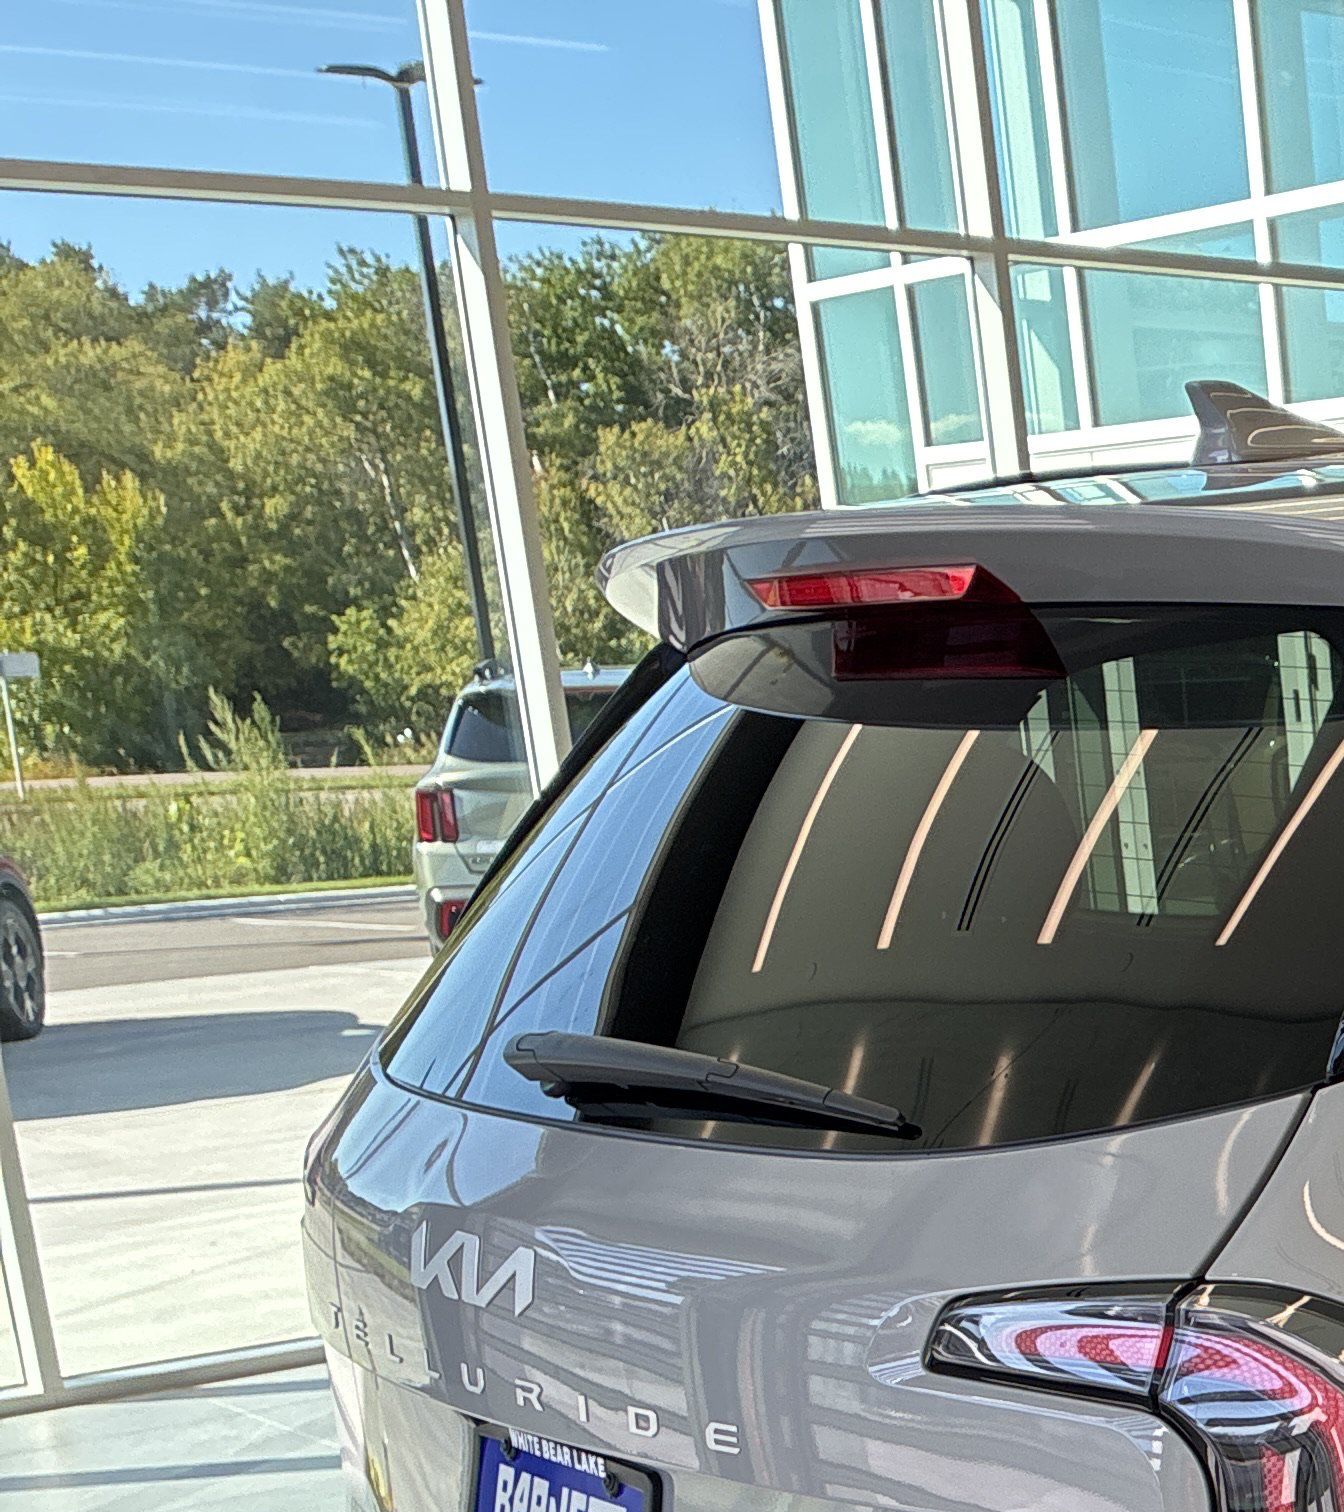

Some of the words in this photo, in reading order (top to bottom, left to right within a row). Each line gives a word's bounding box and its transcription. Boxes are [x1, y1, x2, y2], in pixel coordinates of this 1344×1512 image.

[411, 1220, 536, 1317] KIA
[329, 1302, 741, 1455] TELLURIDE
[508, 1427, 542, 1458] WHITE
[542, 1438, 573, 1468] BEAR
[573, 1448, 607, 1478] LAKE
